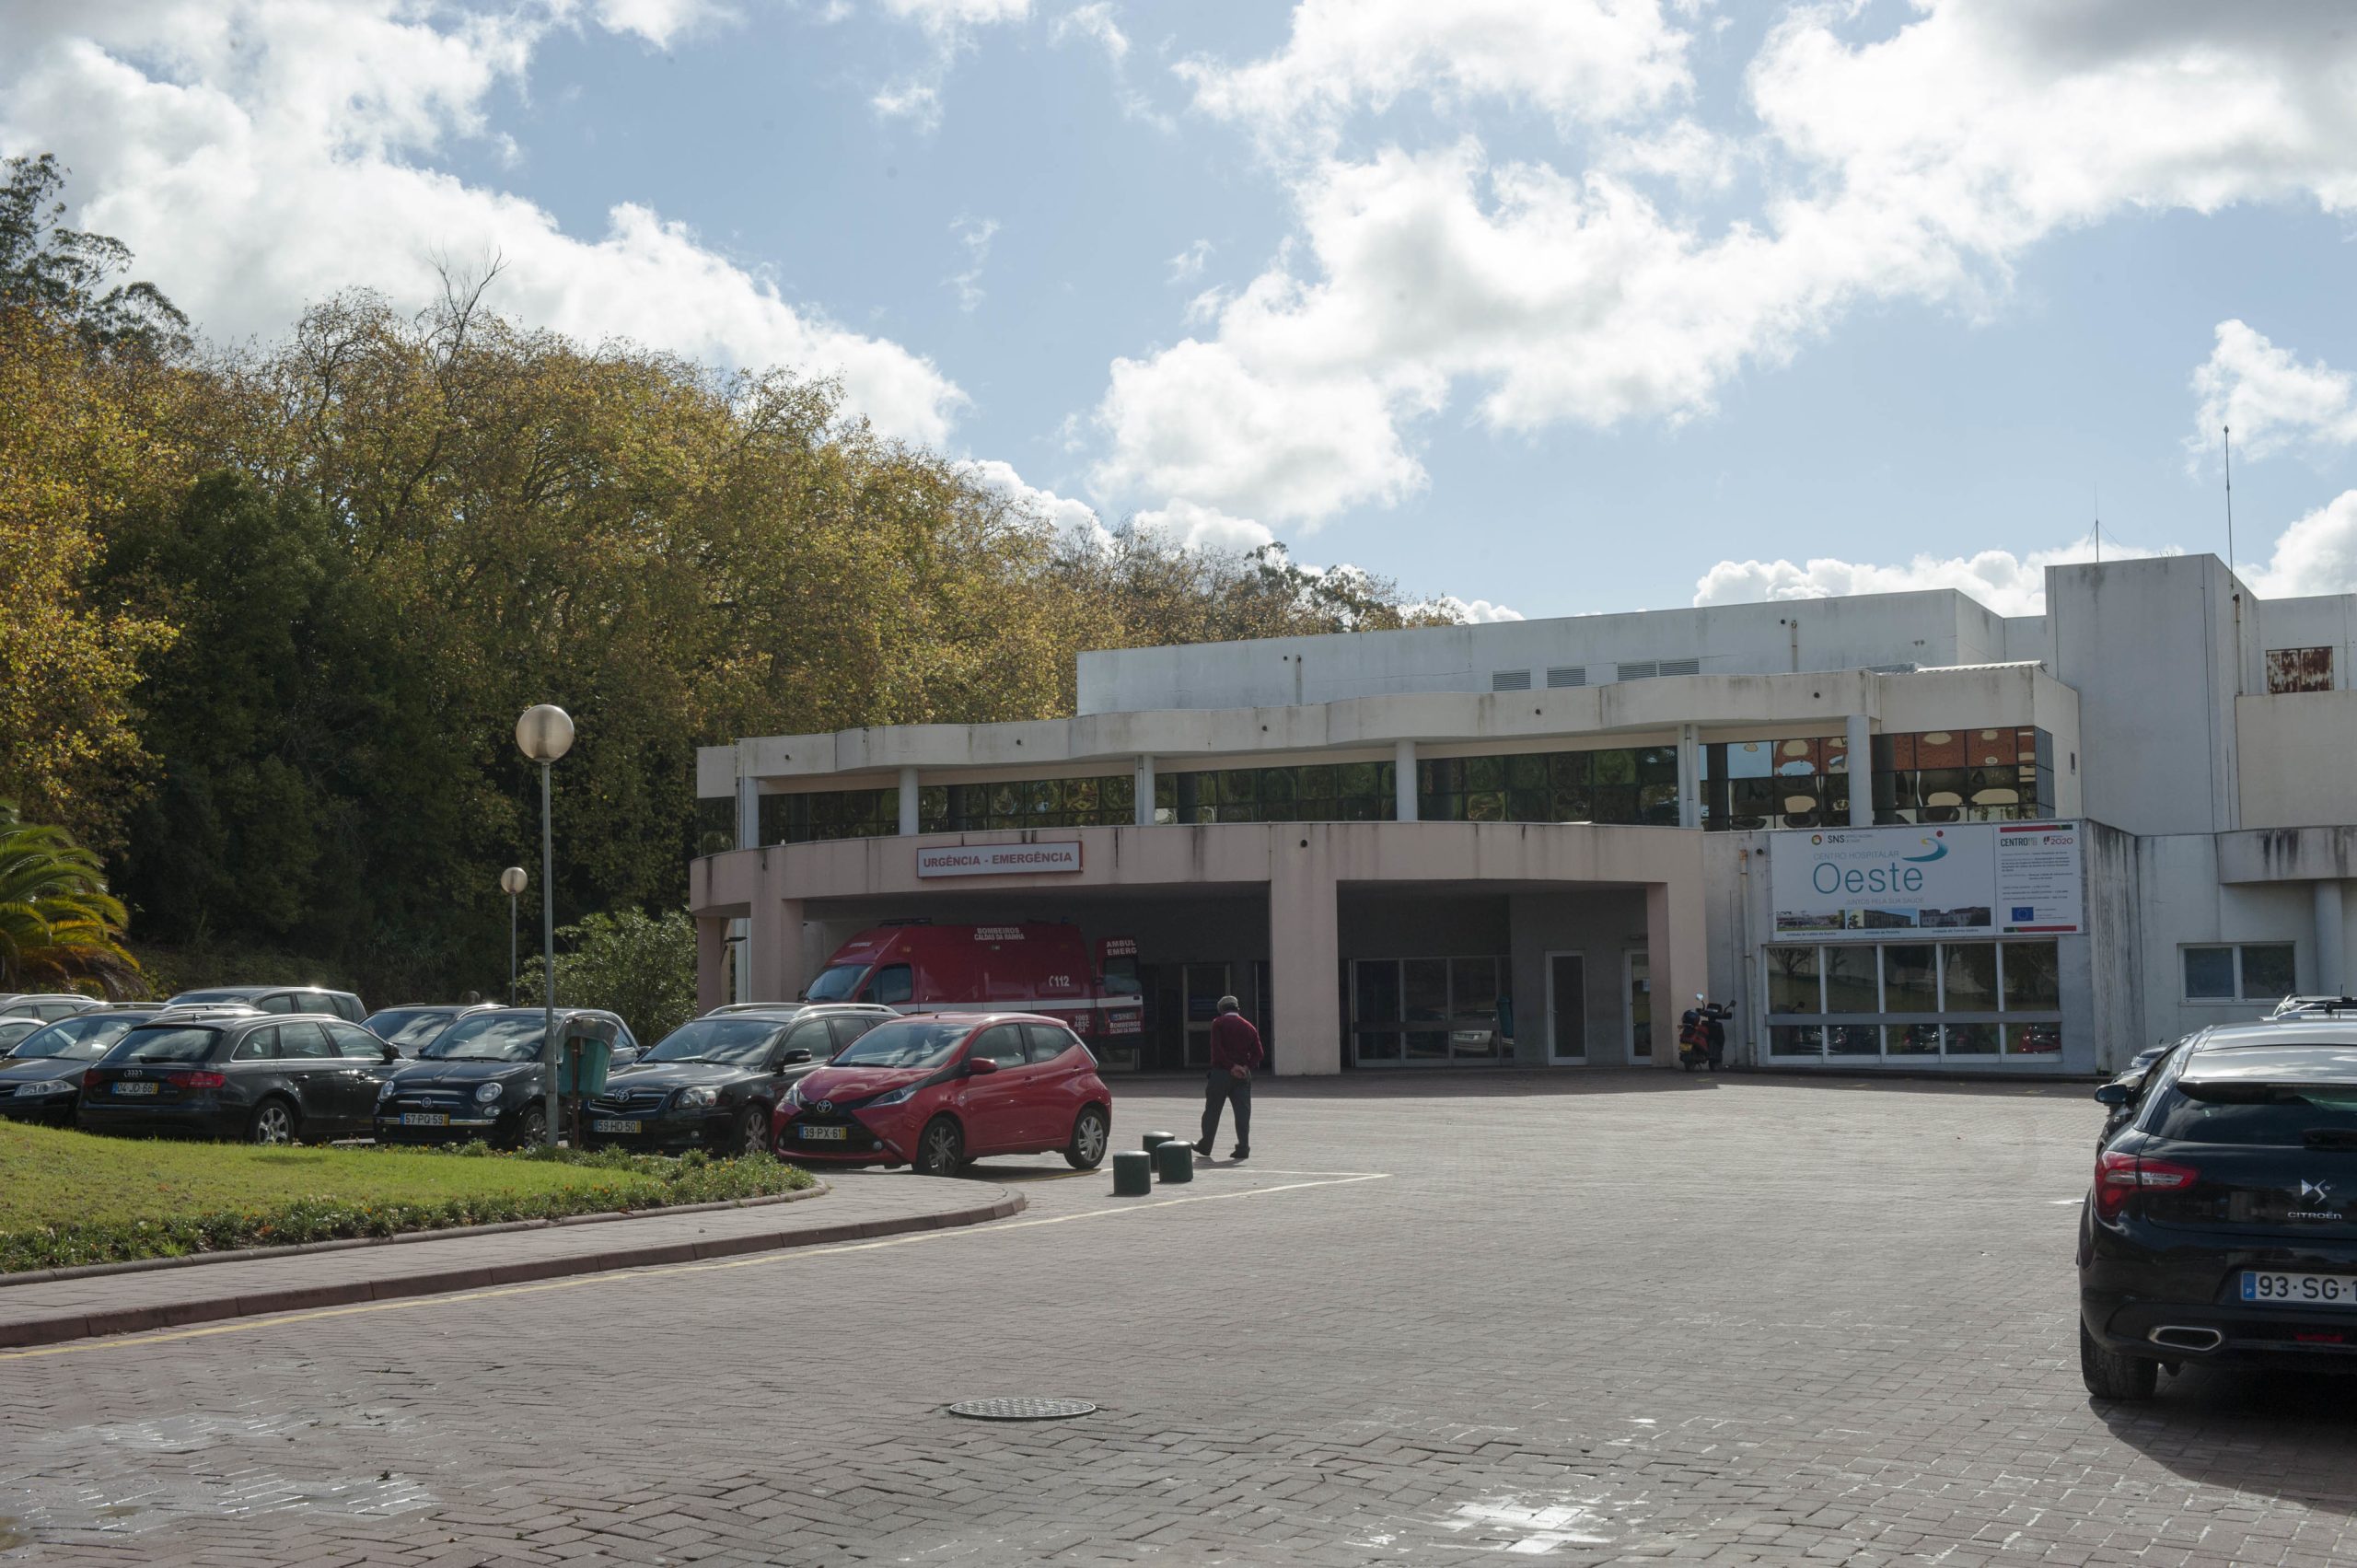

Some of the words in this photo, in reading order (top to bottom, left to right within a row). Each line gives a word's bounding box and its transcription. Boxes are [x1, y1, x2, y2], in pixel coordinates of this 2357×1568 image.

[1828, 834, 1845, 843] SNS
[2001, 837, 2028, 847] CENTRO
[2050, 837, 2073, 845] 2020
[923, 854, 981, 867] URGÊNCIA
[992, 851, 1073, 865] EMERGÊNCIA
[1813, 853, 1847, 862] CENTRO
[1849, 851, 1899, 860] HOSPITALAR
[1813, 862, 1923, 894] Oeste
[1106, 939, 1136, 948] AMBUL
[1107, 947, 1137, 956] EMERG
[1054, 975, 1071, 987] 112
